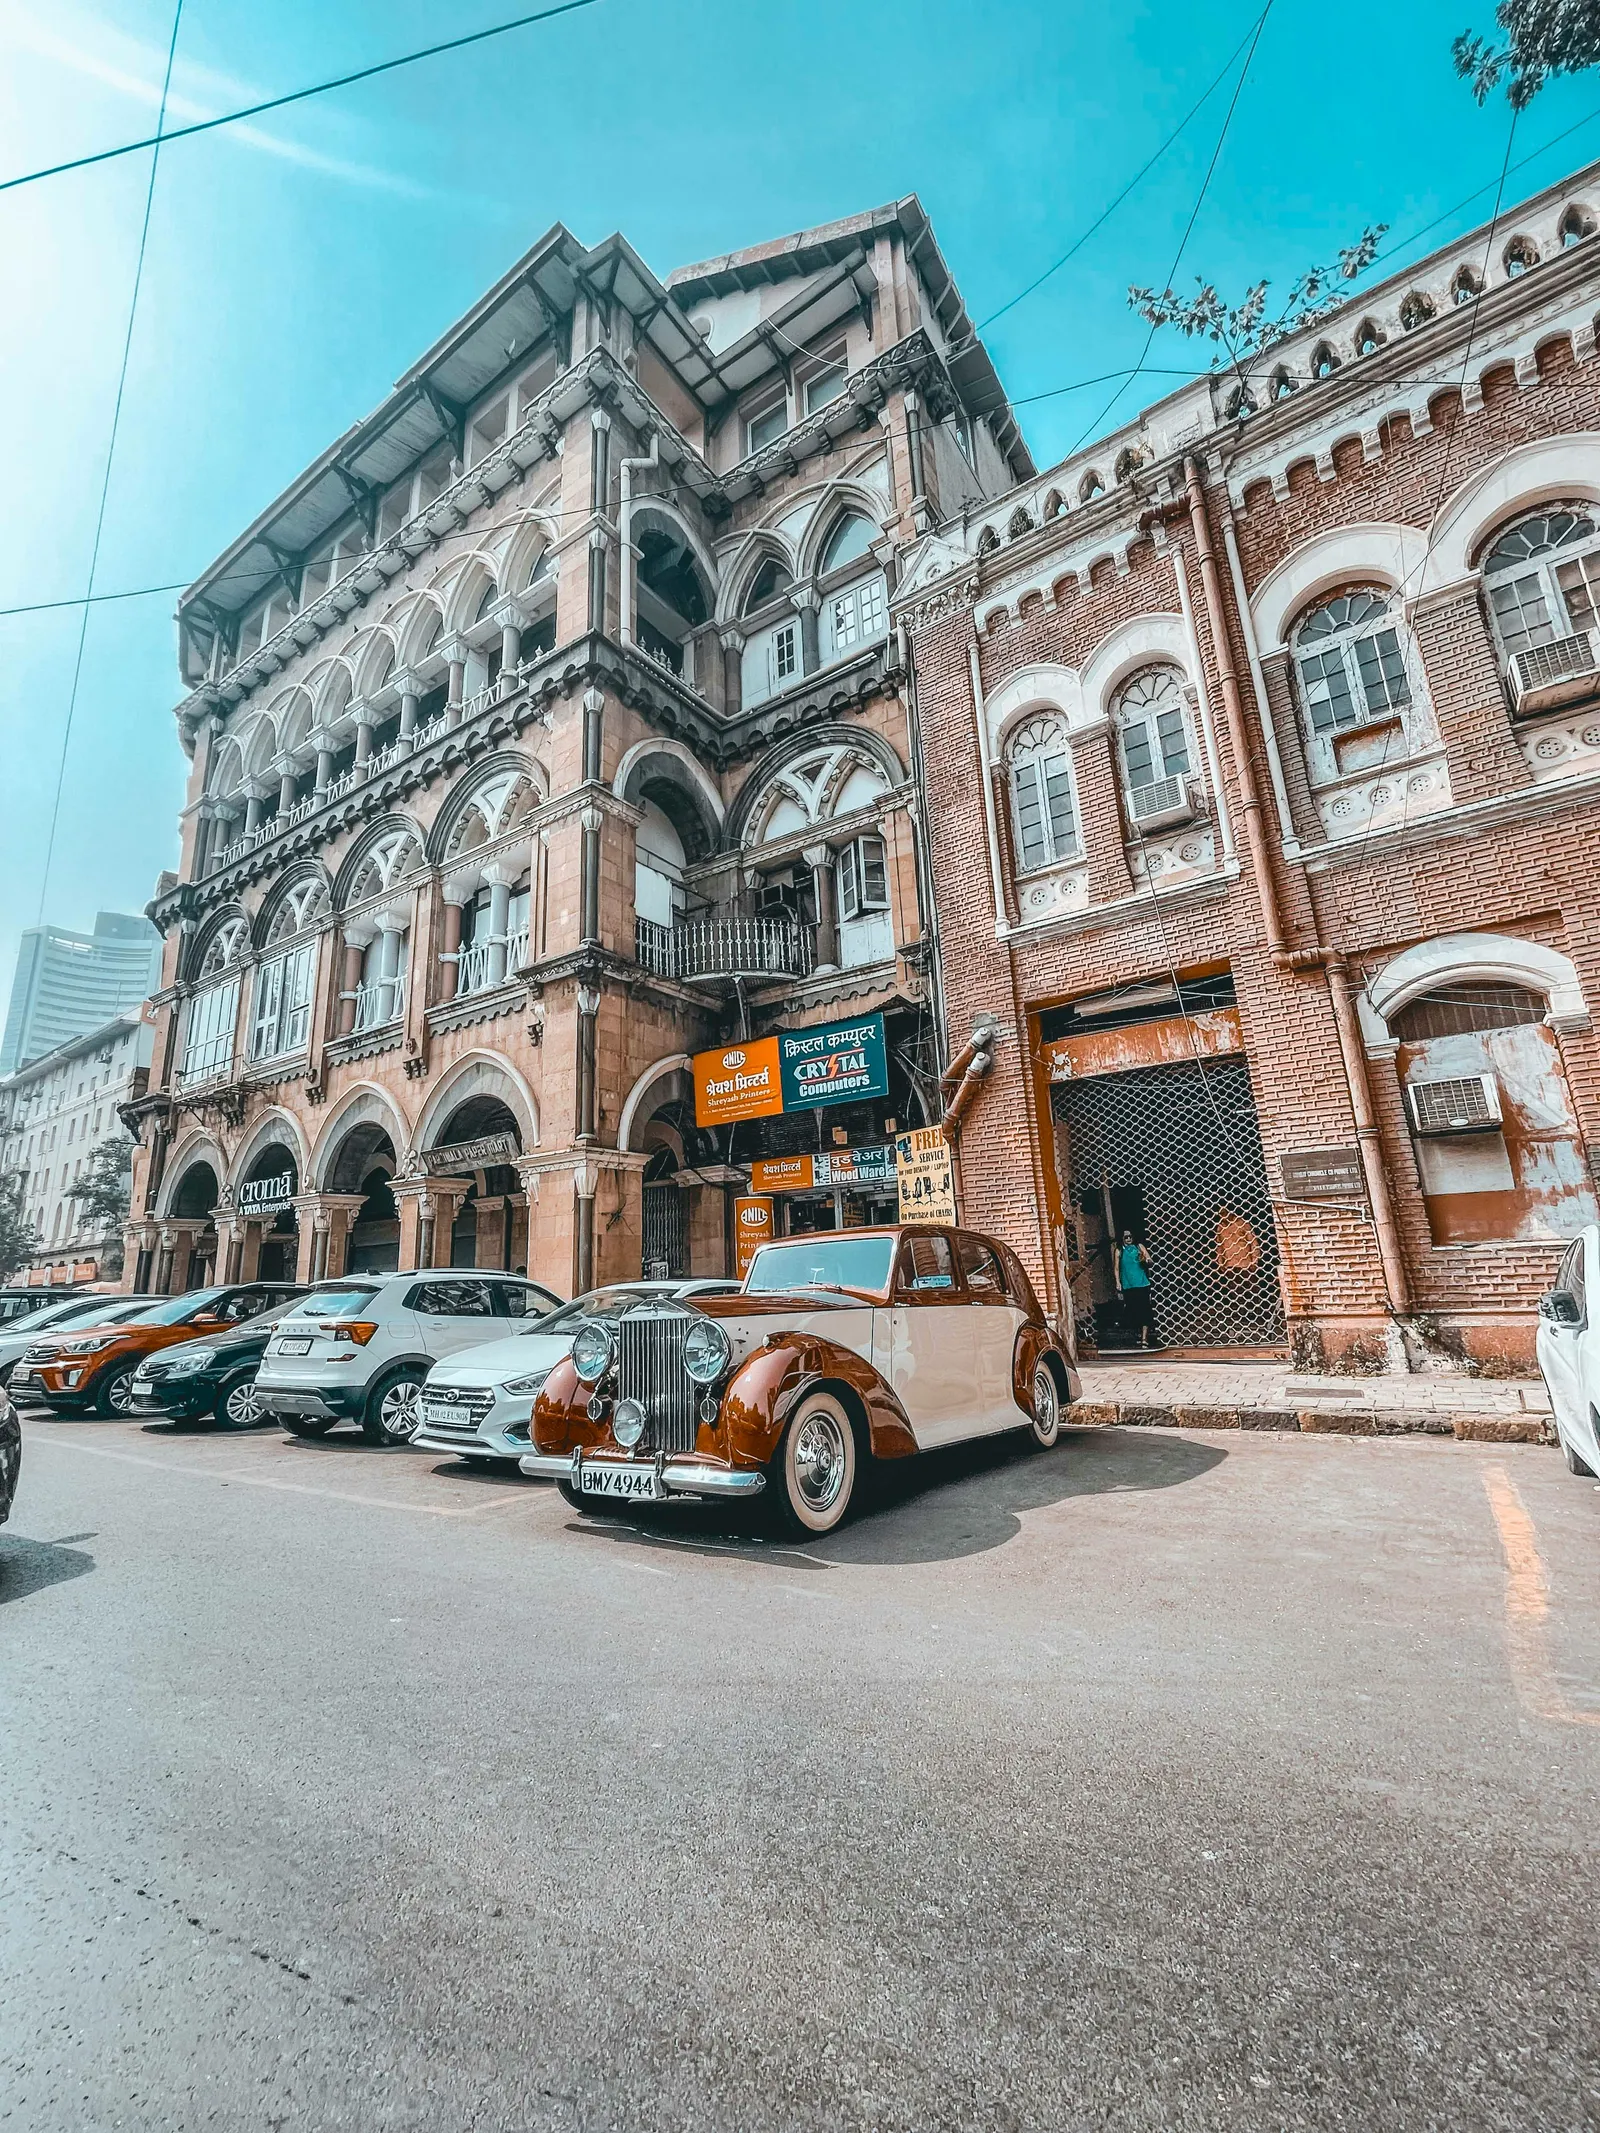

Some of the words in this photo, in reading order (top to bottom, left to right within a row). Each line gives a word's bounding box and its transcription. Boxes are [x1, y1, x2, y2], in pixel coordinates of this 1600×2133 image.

[784, 1036, 825, 1058] क्रिस्टल
[706, 1079, 734, 1096] श्रेयश
[799, 1074, 870, 1097] Computers
[707, 1093, 739, 1107] Shreyash
[740, 1088, 771, 1100] Printers
[915, 1128, 946, 1151] FREE
[464, 1143, 487, 1158] PAPER
[919, 1150, 944, 1163] SERVICE
[831, 1167, 858, 1182] Wood
[859, 1166, 885, 1179] Ware
[239, 1205, 243, 1216] A
[244, 1203, 261, 1216] TATA
[261, 1199, 291, 1214] Enterprise
[908, 1209, 929, 1220] Purchase
[935, 1208, 953, 1217] CHAIRS
[740, 1230, 770, 1239] Shreyash
